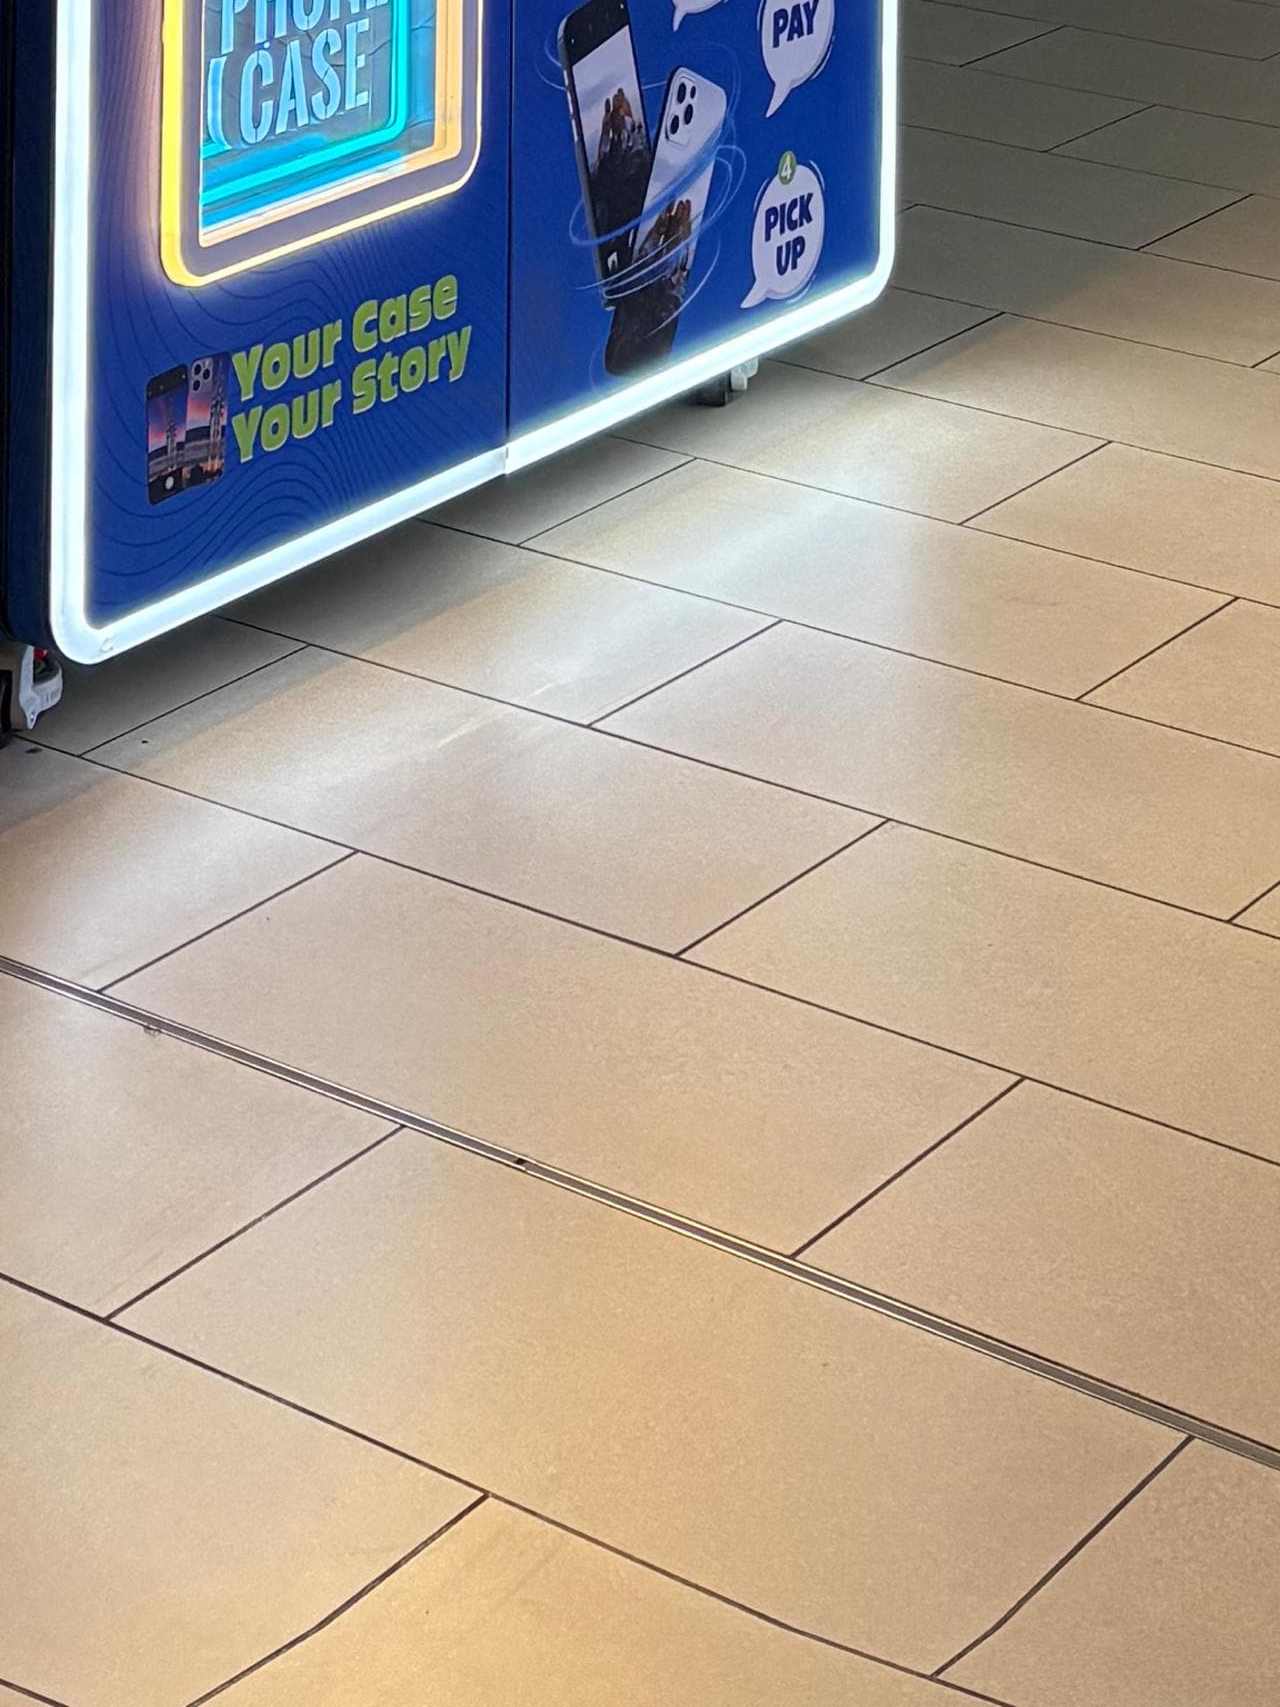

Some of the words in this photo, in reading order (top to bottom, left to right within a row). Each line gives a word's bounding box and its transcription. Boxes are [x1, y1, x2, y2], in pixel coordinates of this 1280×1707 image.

[240, 18, 369, 144] CASE
[764, 192, 814, 242] PICK
[776, 235, 806, 276] UP
[231, 380, 342, 464] Your
[352, 325, 472, 414] Story
[232, 319, 342, 402] Your
[352, 275, 458, 353] Case
